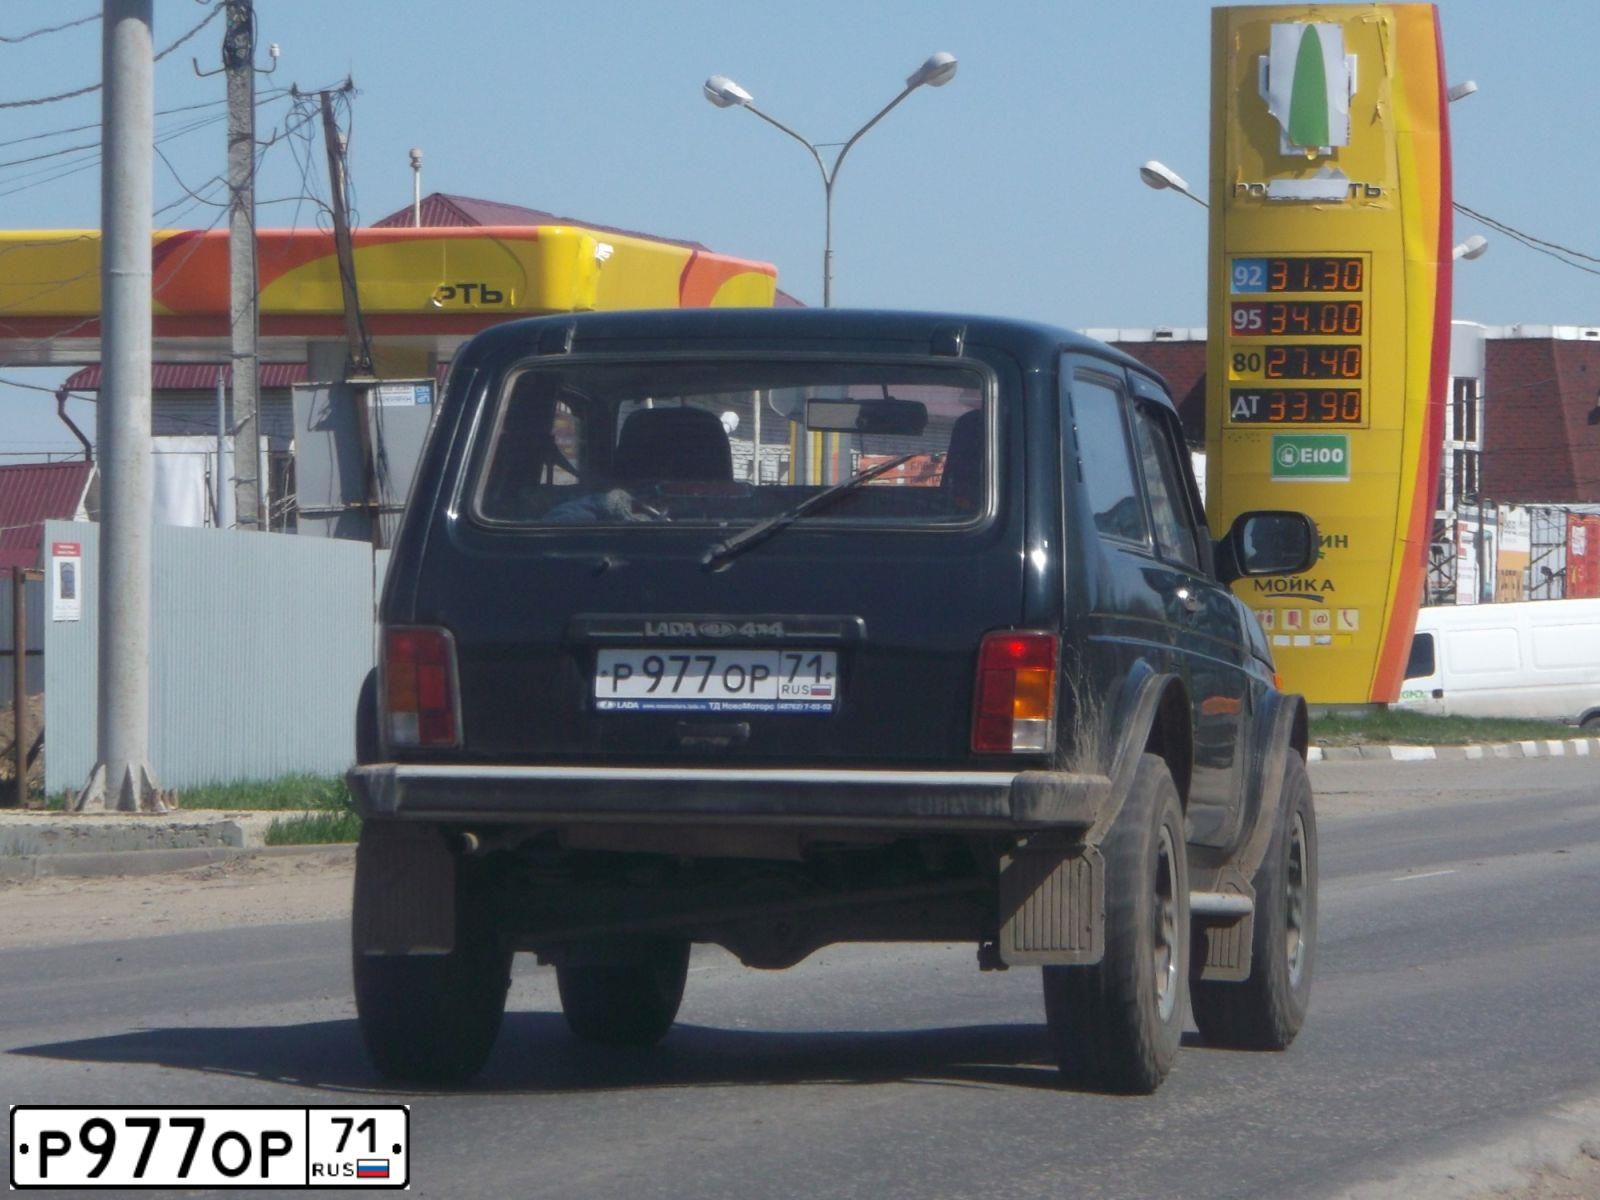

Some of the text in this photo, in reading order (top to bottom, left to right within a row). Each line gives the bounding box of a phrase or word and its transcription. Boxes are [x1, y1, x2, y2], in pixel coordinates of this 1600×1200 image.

[1234, 261, 1362, 290] 92 31.30
[1233, 304, 1362, 333] 95 34.00
[1232, 348, 1361, 378] 80 27.40
[1231, 391, 1361, 421] ДТ 33.90
[1300, 447, 1344, 464] E100
[1253, 576, 1336, 593] МОЙКА
[644, 621, 697, 638] LADA
[785, 654, 823, 684] 71
[781, 684, 809, 695] RUS
[616, 701, 640, 709] LADA
